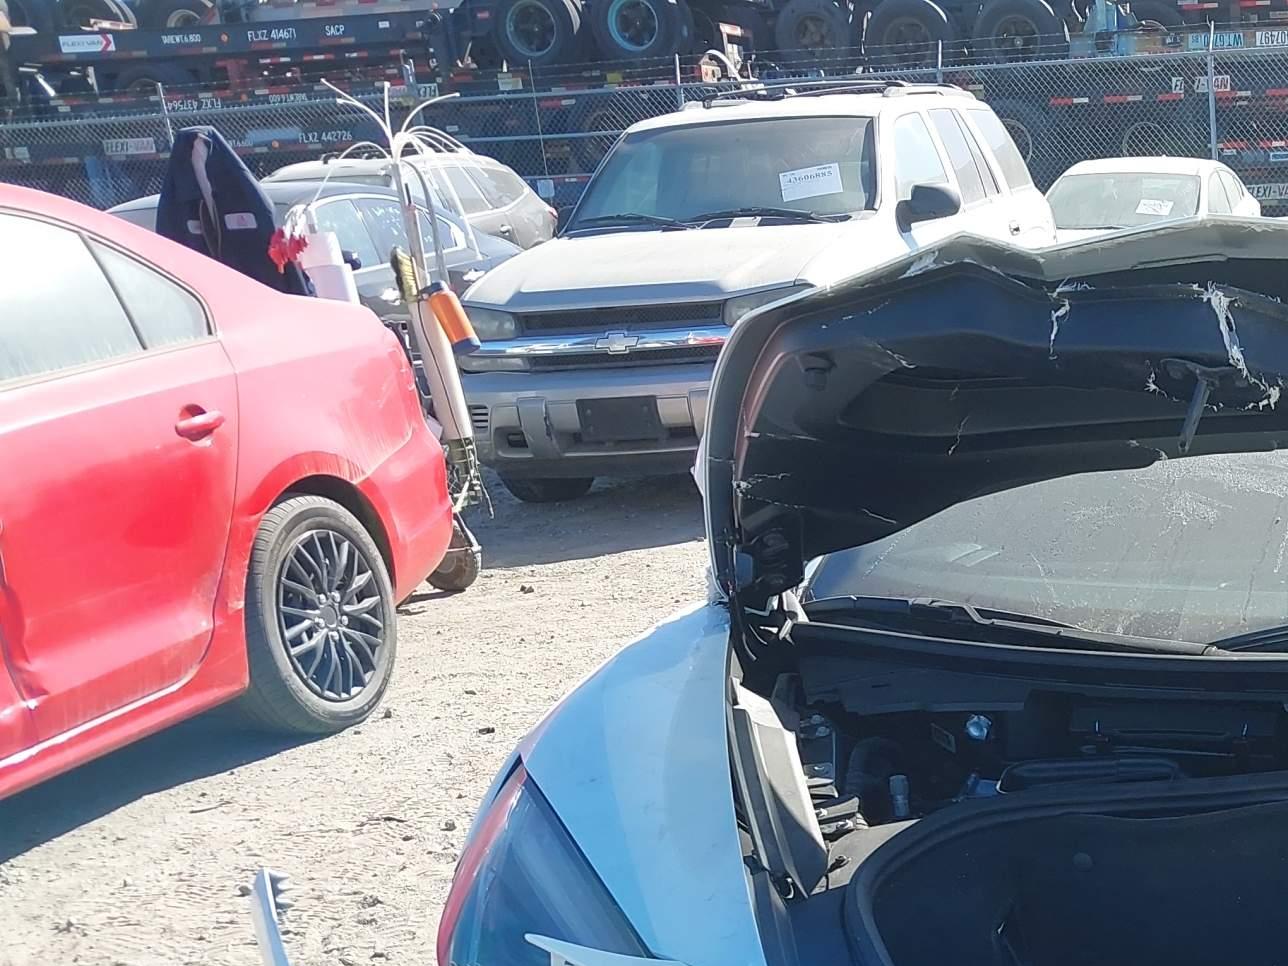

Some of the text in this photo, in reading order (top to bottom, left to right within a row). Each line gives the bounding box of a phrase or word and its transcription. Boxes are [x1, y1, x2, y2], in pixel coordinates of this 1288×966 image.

[247, 28, 297, 42] FLXZ 414671
[325, 25, 345, 36] SACP
[202, 97, 222, 110] FLXZ
[299, 130, 352, 143] FLXZ 442726
